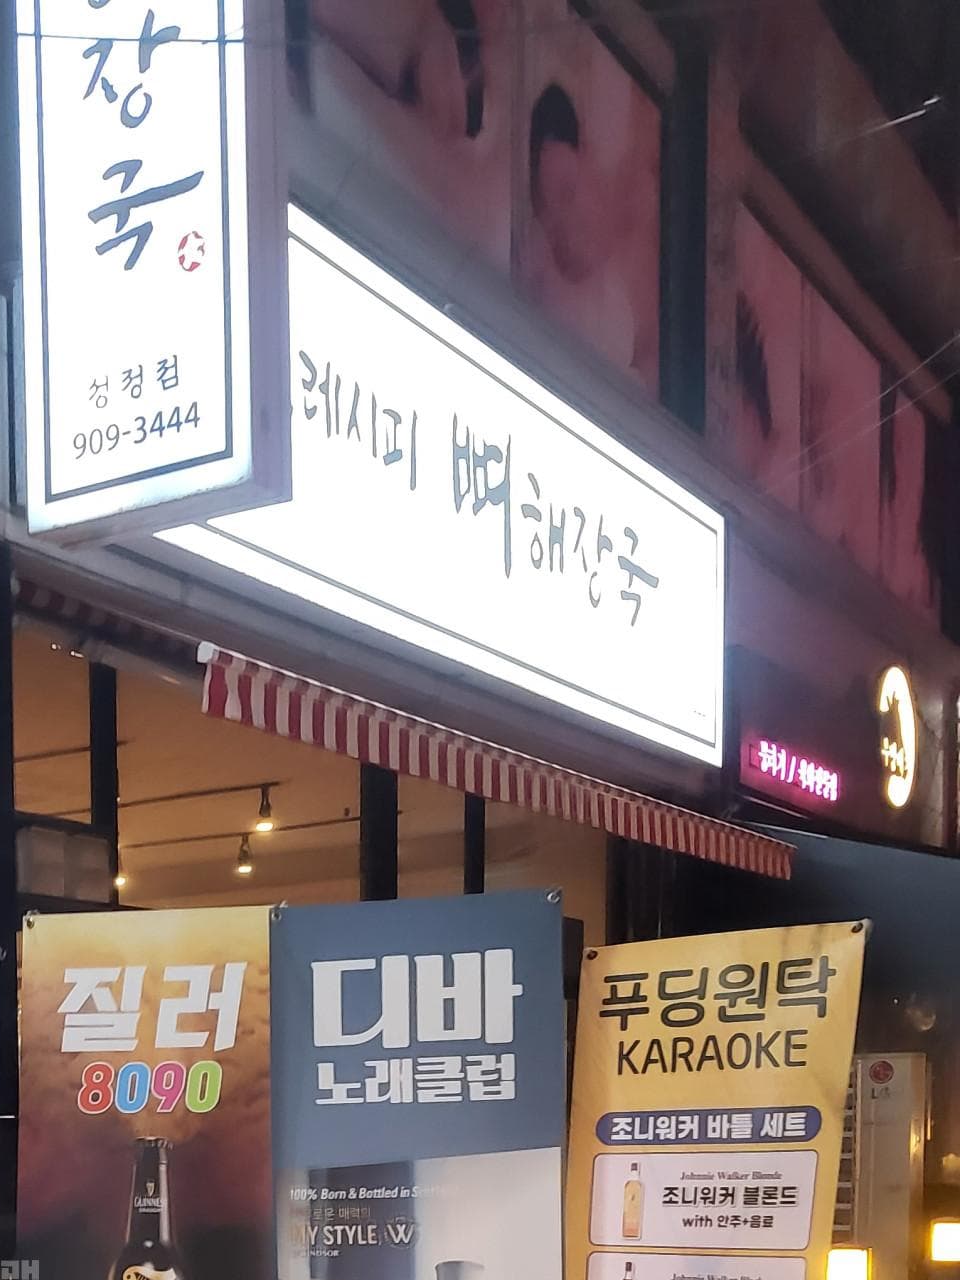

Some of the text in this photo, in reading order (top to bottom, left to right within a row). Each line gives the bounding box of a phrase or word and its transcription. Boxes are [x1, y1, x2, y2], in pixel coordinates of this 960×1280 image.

[88, 354, 180, 409] 성정점
[73, 401, 201, 459] 909-3444
[298, 350, 417, 491] 레시피
[57, 961, 248, 1052] 질러
[311, 949, 524, 1049] 디바
[599, 955, 837, 1031] 푸딩원탁
[315, 1053, 516, 1104] 노래클럽
[617, 1029, 808, 1076] KARAOKE
[77, 1060, 223, 1114] 8090
[611, 1111, 807, 1140] 조니워커 바틀 세트
[290, 1188, 317, 1200] 100%
[320, 1188, 346, 1200] Born
[348, 1188, 357, 1200] &
[358, 1186, 398, 1199] Bottled
[400, 1186, 410, 1198] in
[662, 1186, 798, 1206] 조니워커 블론드
[323, 1224, 382, 1246] STYLE,
[682, 1215, 774, 1228] with 안주+음료
